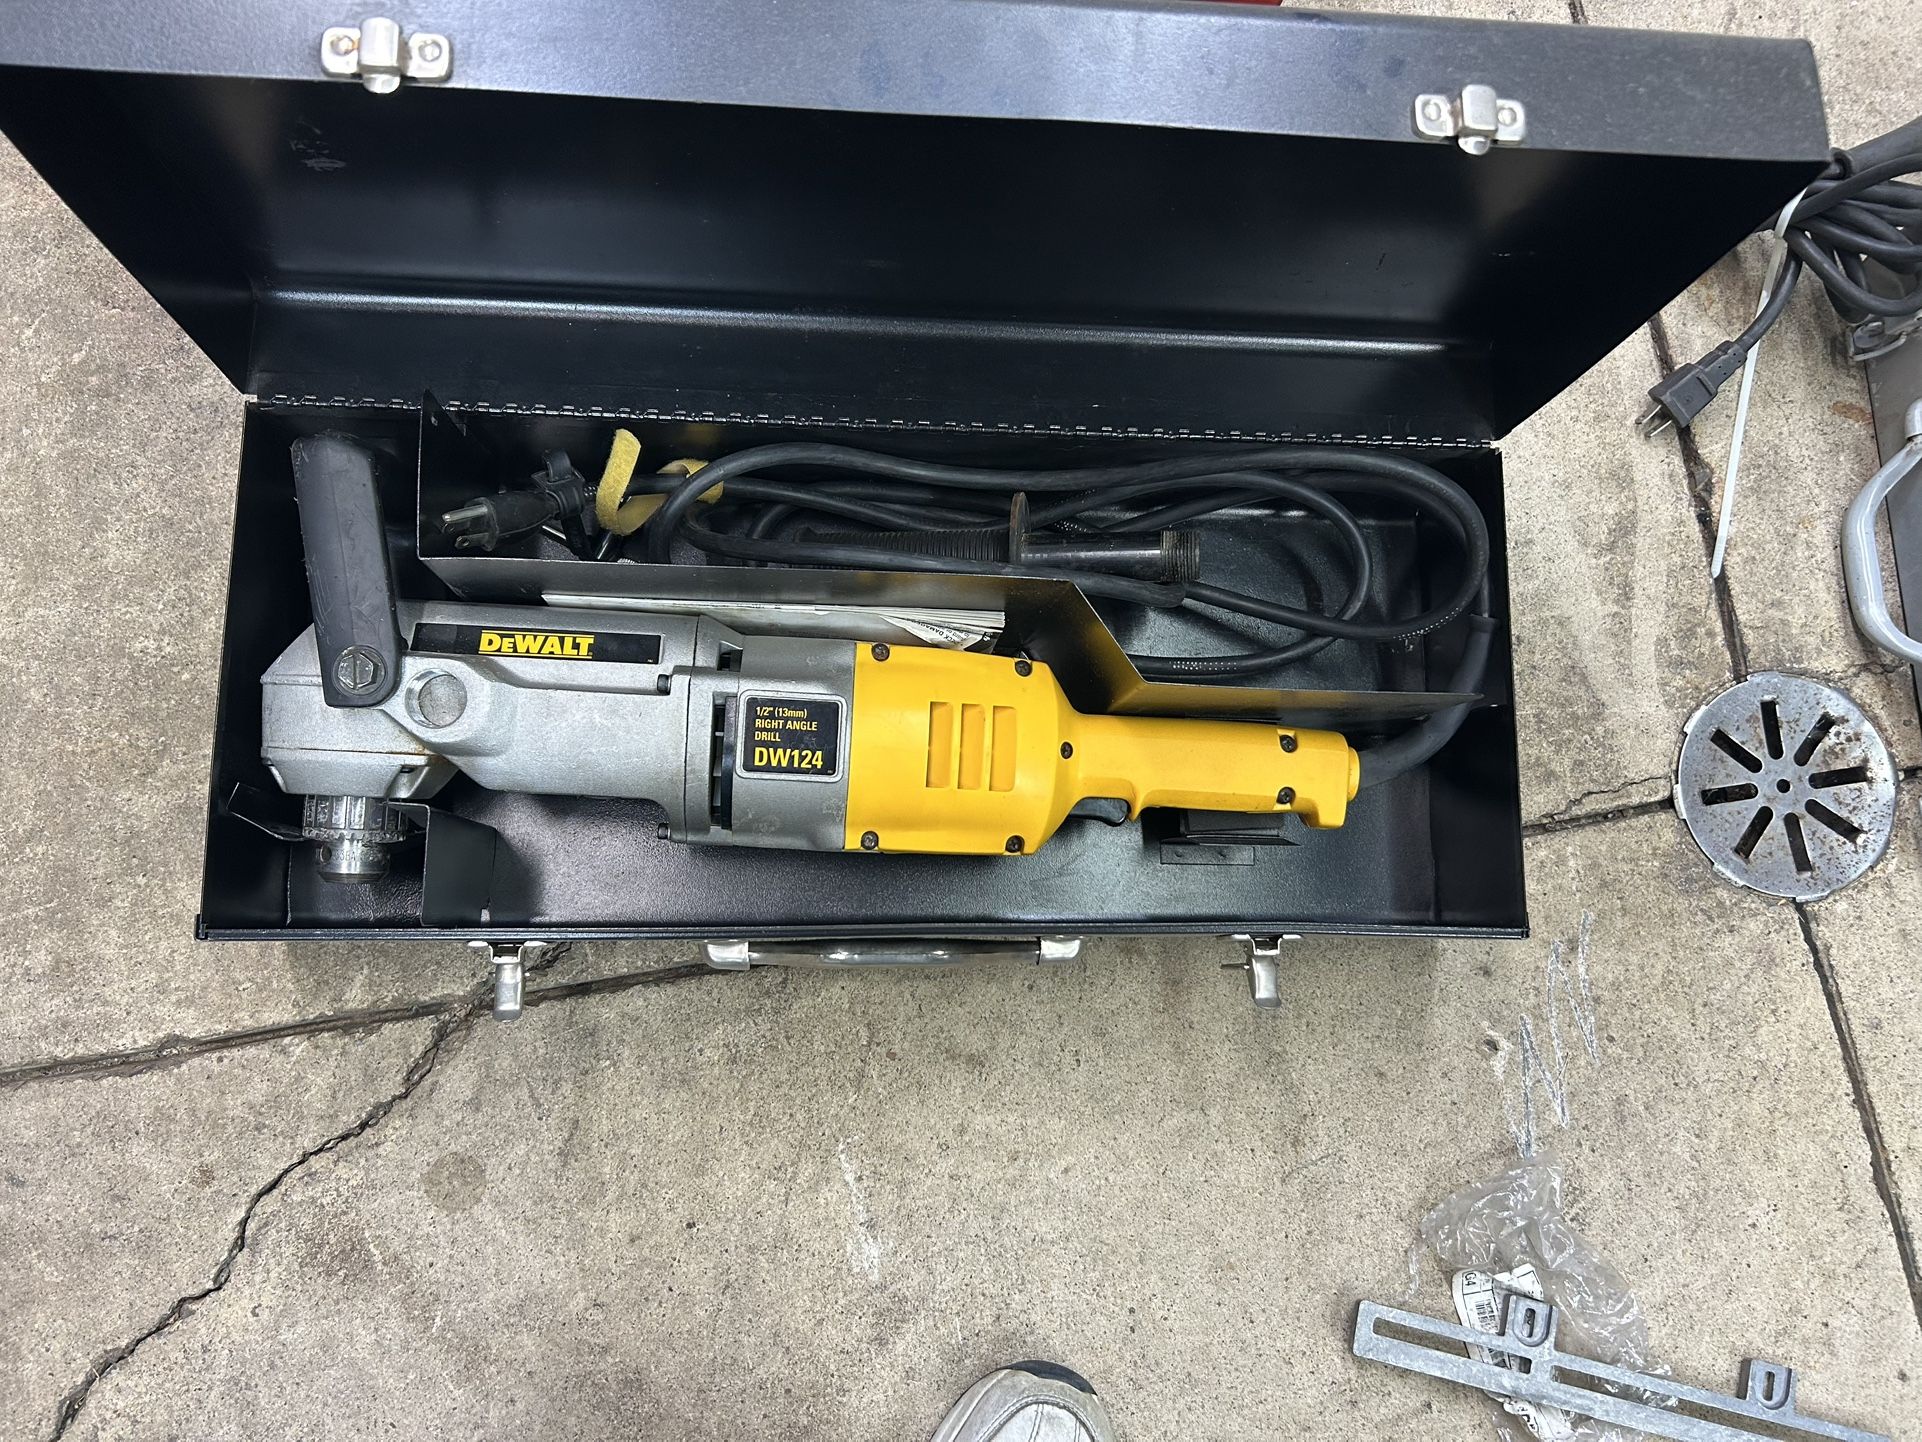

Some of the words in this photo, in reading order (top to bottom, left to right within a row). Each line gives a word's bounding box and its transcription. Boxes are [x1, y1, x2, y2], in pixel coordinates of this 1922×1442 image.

[755, 706, 774, 717] 1/2"
[774, 707, 808, 719] (13mm)
[755, 719, 785, 730] RIGHT
[785, 720, 818, 731] ANGLE
[754, 731, 781, 742] DRILL
[753, 746, 824, 769] DW124
[1464, 1272, 1477, 1286] G4
